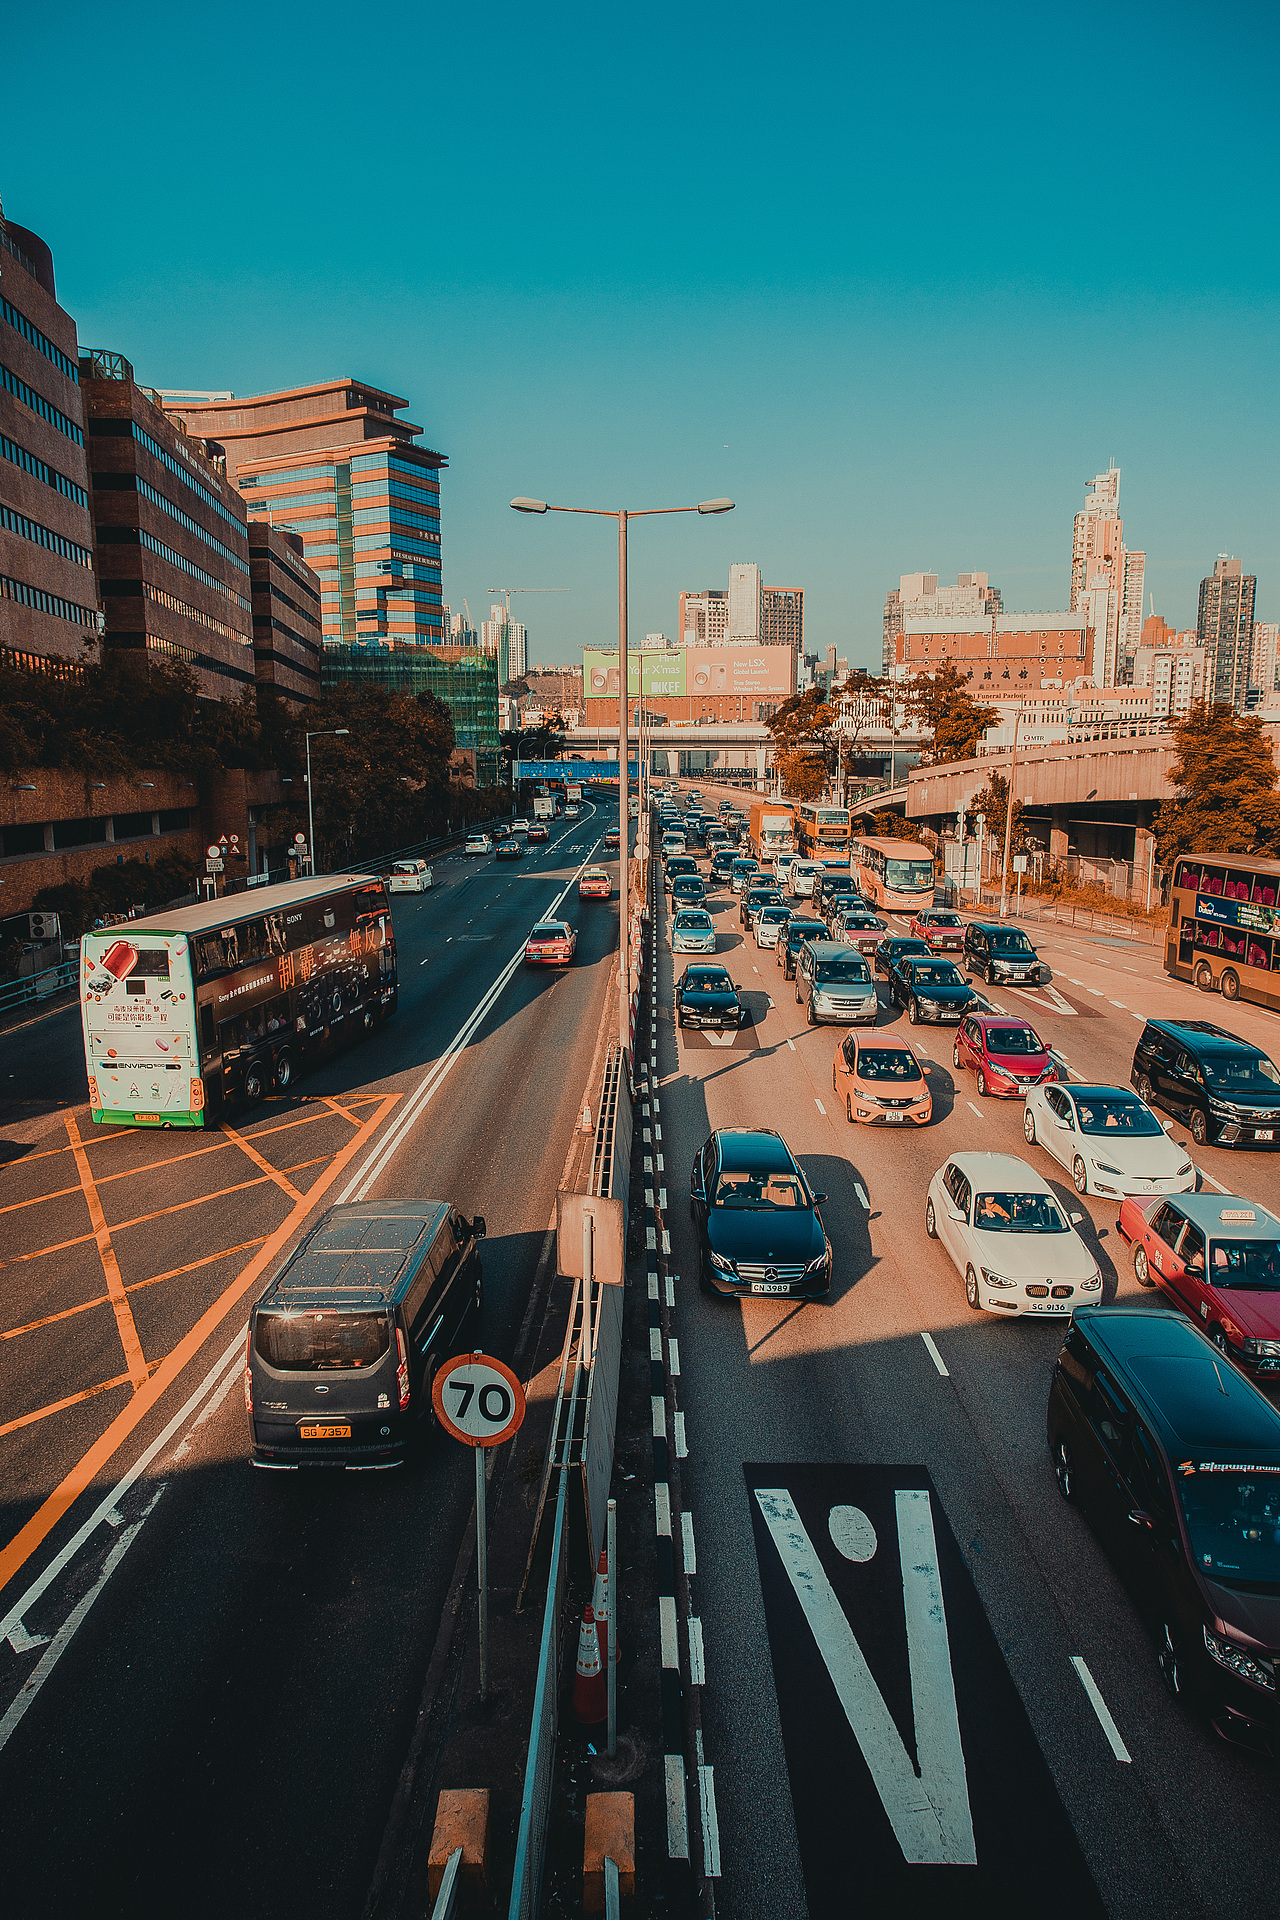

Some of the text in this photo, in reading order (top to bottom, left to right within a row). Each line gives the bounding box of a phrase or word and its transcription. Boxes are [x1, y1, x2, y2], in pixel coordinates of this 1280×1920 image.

[422, 558, 440, 566] BUILDING
[748, 658, 766, 667] LSX
[629, 664, 680, 675] Your X'mas
[662, 682, 680, 693] KEF
[286, 913, 303, 925] SONY
[218, 993, 230, 1003] Sony
[767, 1284, 788, 1292] 3989
[1046, 1303, 1066, 1311] 9136
[449, 1381, 511, 1422] 70
[303, 1427, 348, 1437] SG 7357
